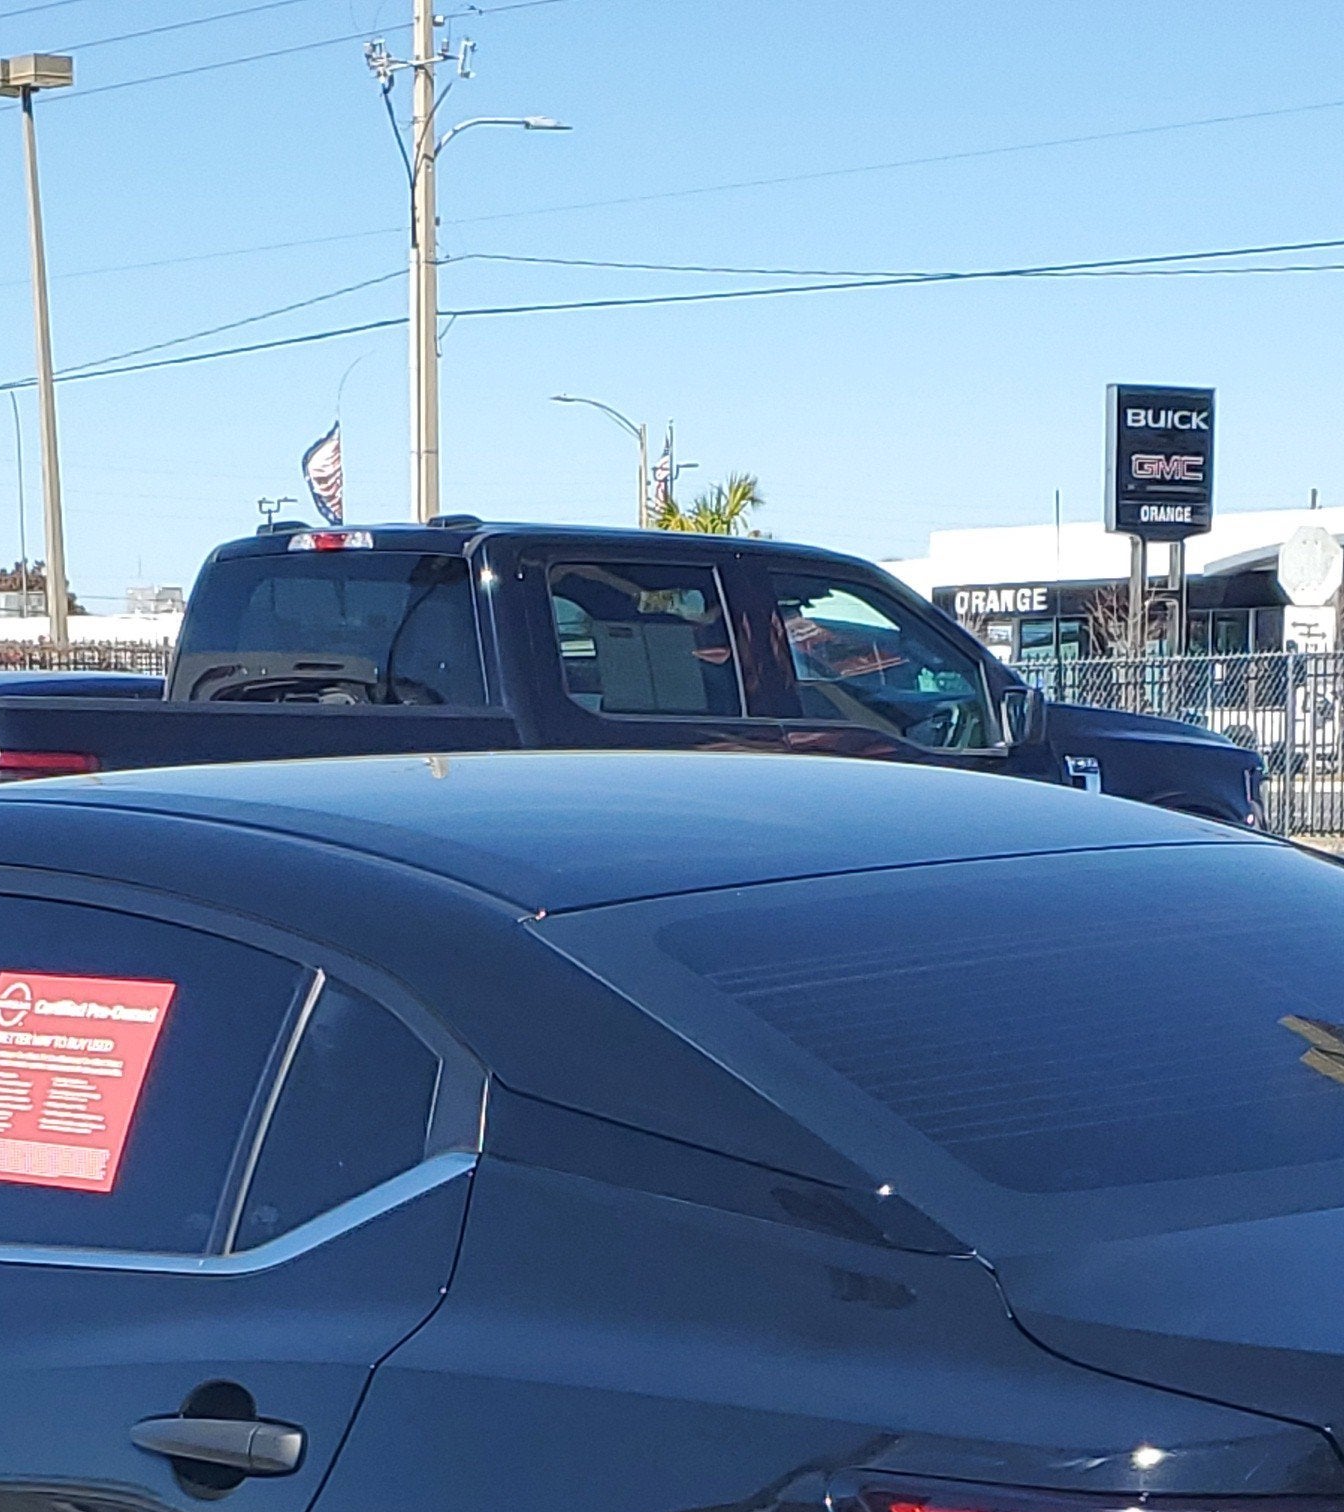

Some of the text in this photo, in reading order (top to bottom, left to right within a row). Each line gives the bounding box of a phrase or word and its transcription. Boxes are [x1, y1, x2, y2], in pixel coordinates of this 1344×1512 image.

[1126, 408, 1210, 430] BUICK
[1131, 454, 1204, 481] GMC
[1140, 505, 1193, 523] ORANGE
[954, 587, 1049, 615] ORANGE
[34, 999, 89, 1018] Certified
[86, 1003, 159, 1023] Pre-Owned
